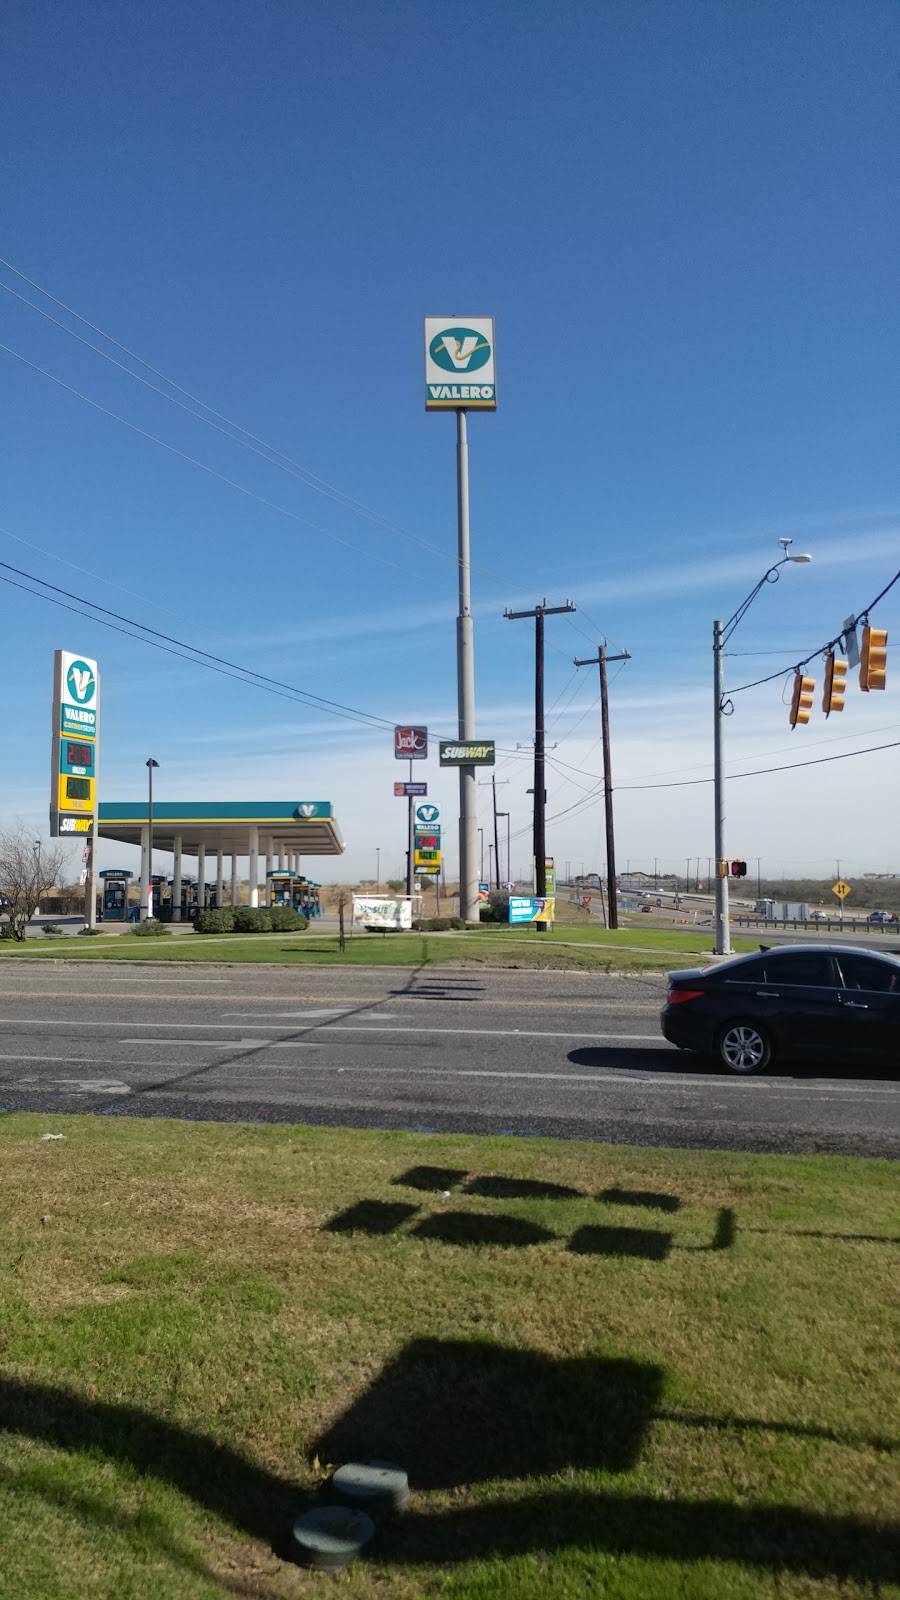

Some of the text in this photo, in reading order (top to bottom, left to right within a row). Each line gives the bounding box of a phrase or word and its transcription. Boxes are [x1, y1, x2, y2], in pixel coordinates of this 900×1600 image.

[429, 386, 493, 399] VALERO
[64, 707, 96, 724] VALERO
[441, 746, 494, 759] SUBWAY
[60, 818, 94, 832] SUBWAY
